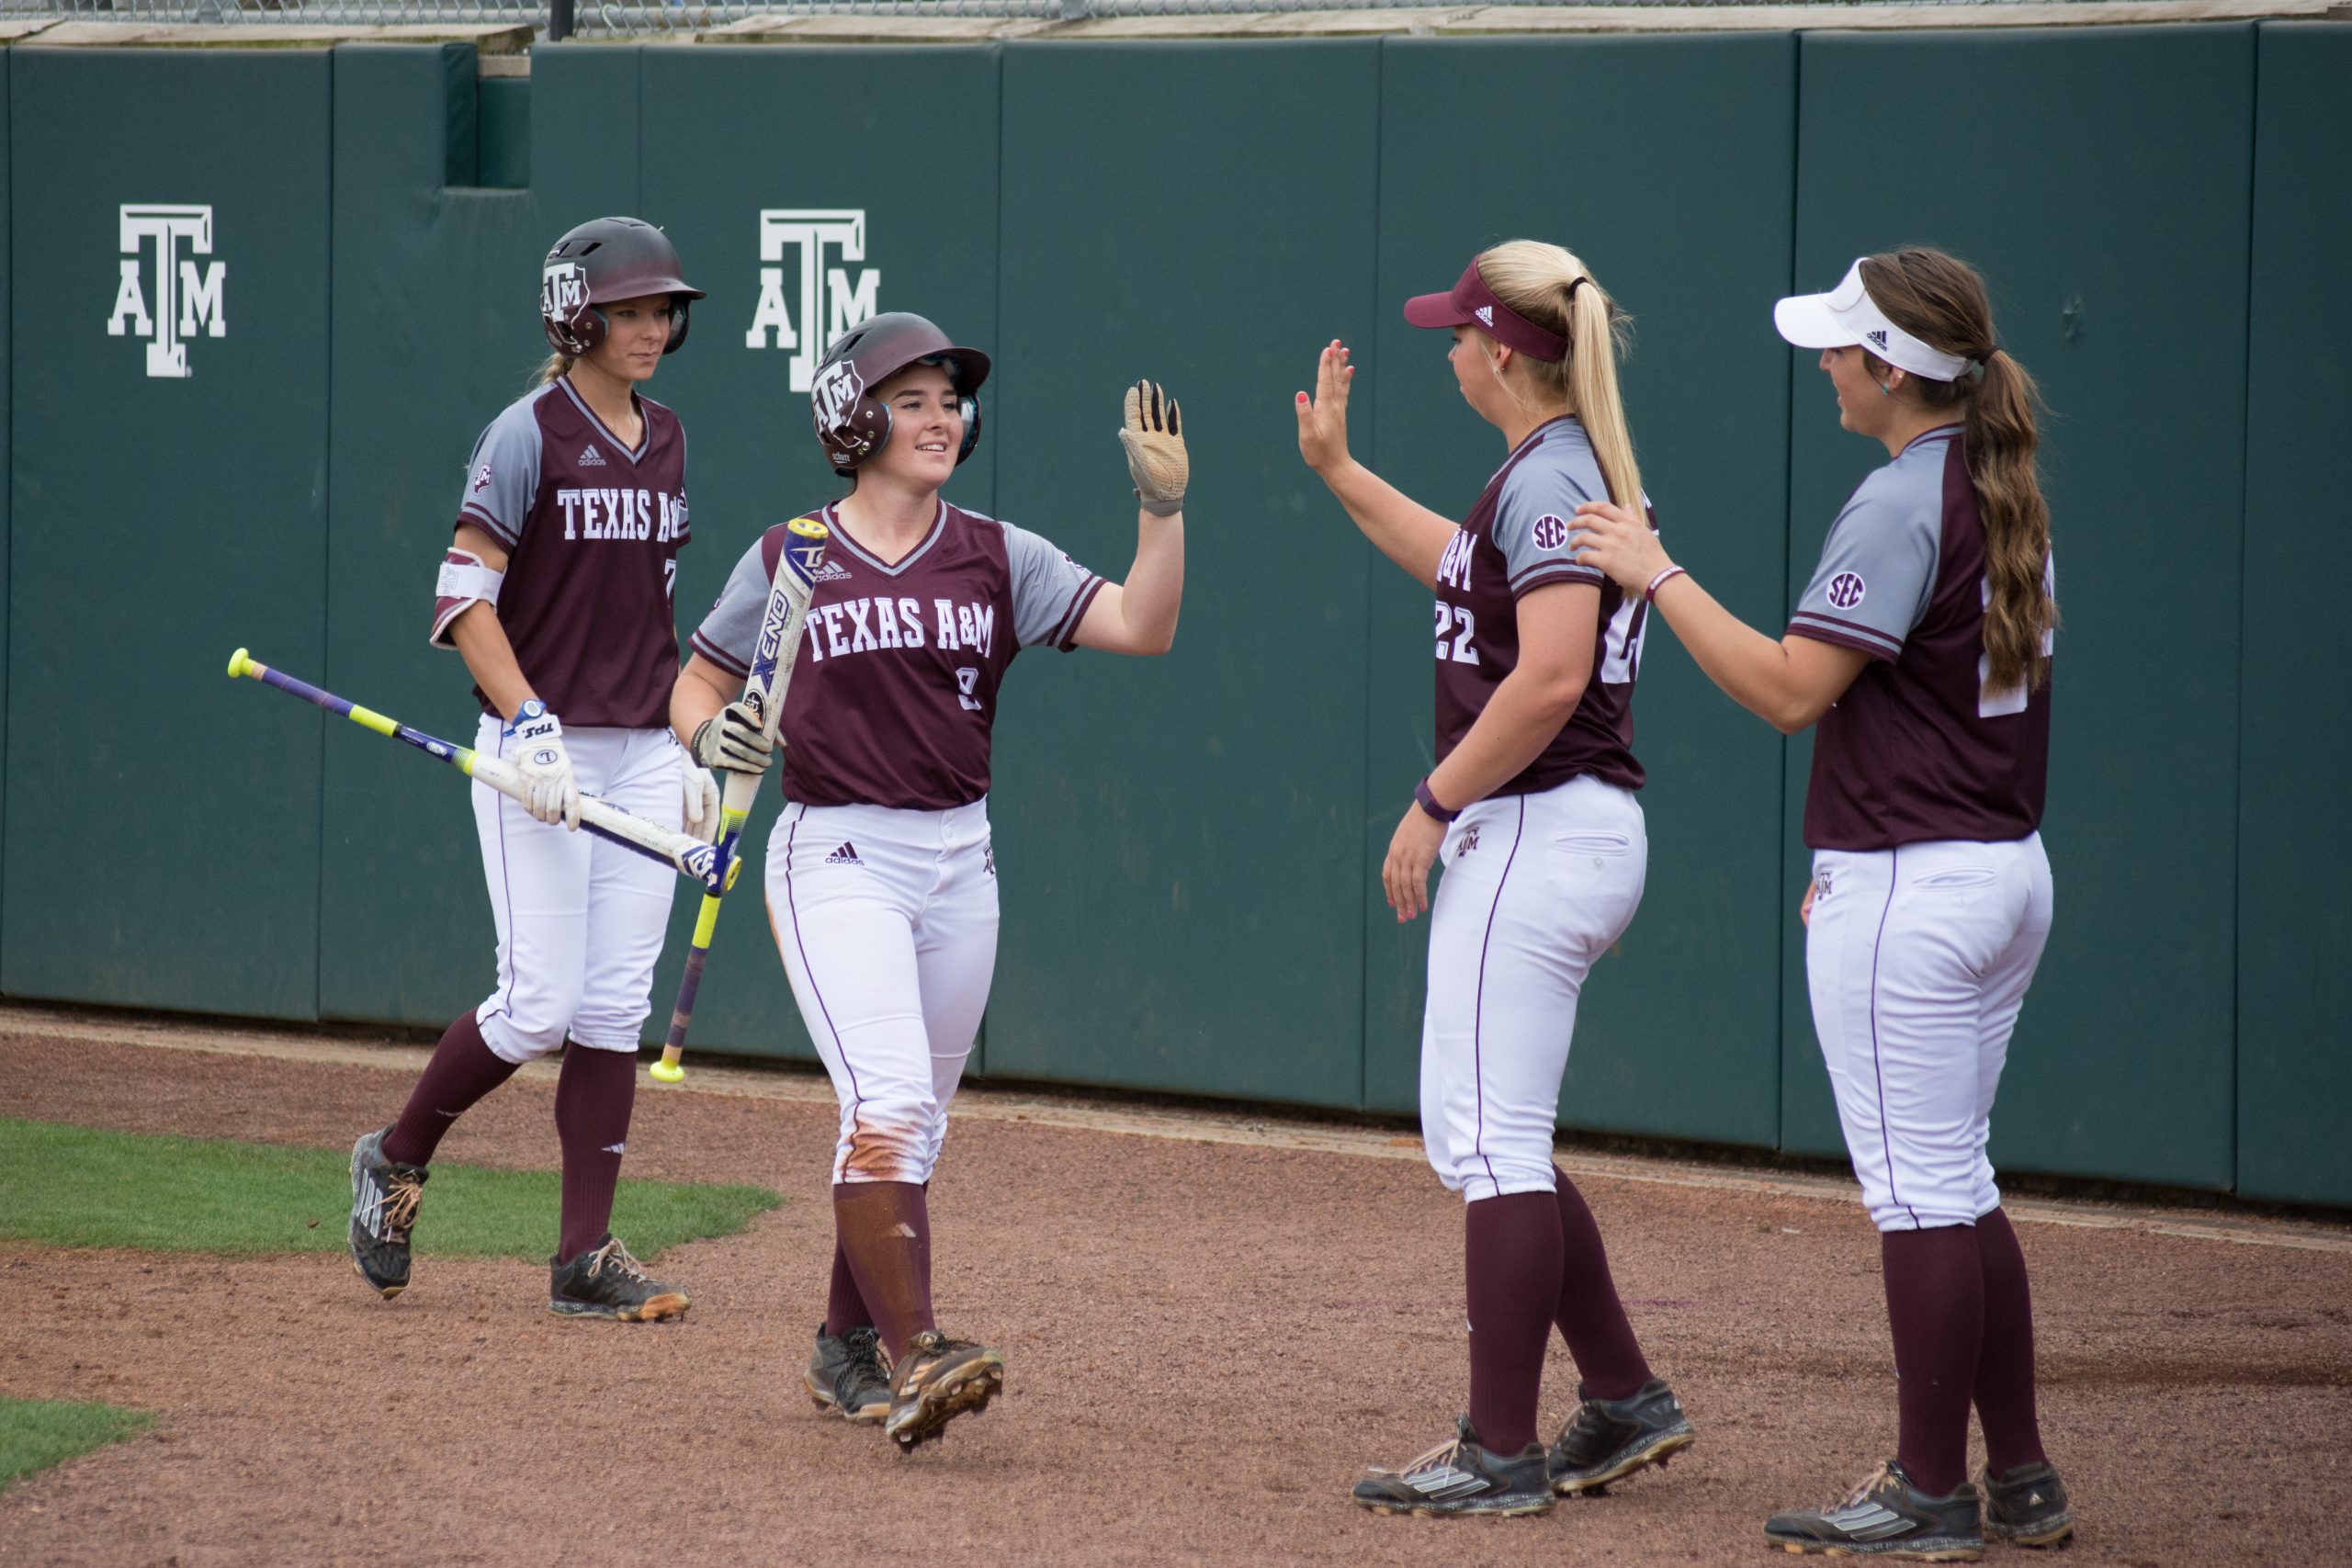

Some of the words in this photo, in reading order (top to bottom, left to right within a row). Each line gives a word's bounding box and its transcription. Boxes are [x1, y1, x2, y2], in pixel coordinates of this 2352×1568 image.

[578, 457, 606, 466] adidas
[557, 489, 651, 540] TEXAS
[1533, 515, 1566, 549] SEC
[815, 571, 854, 583] adidas
[1828, 572, 1864, 608] SEC
[752, 590, 790, 696] XENO
[803, 597, 925, 663] TEXAS
[933, 598, 994, 659] A&M
[1435, 600, 1480, 666] 22
[825, 855, 865, 866] adidas
